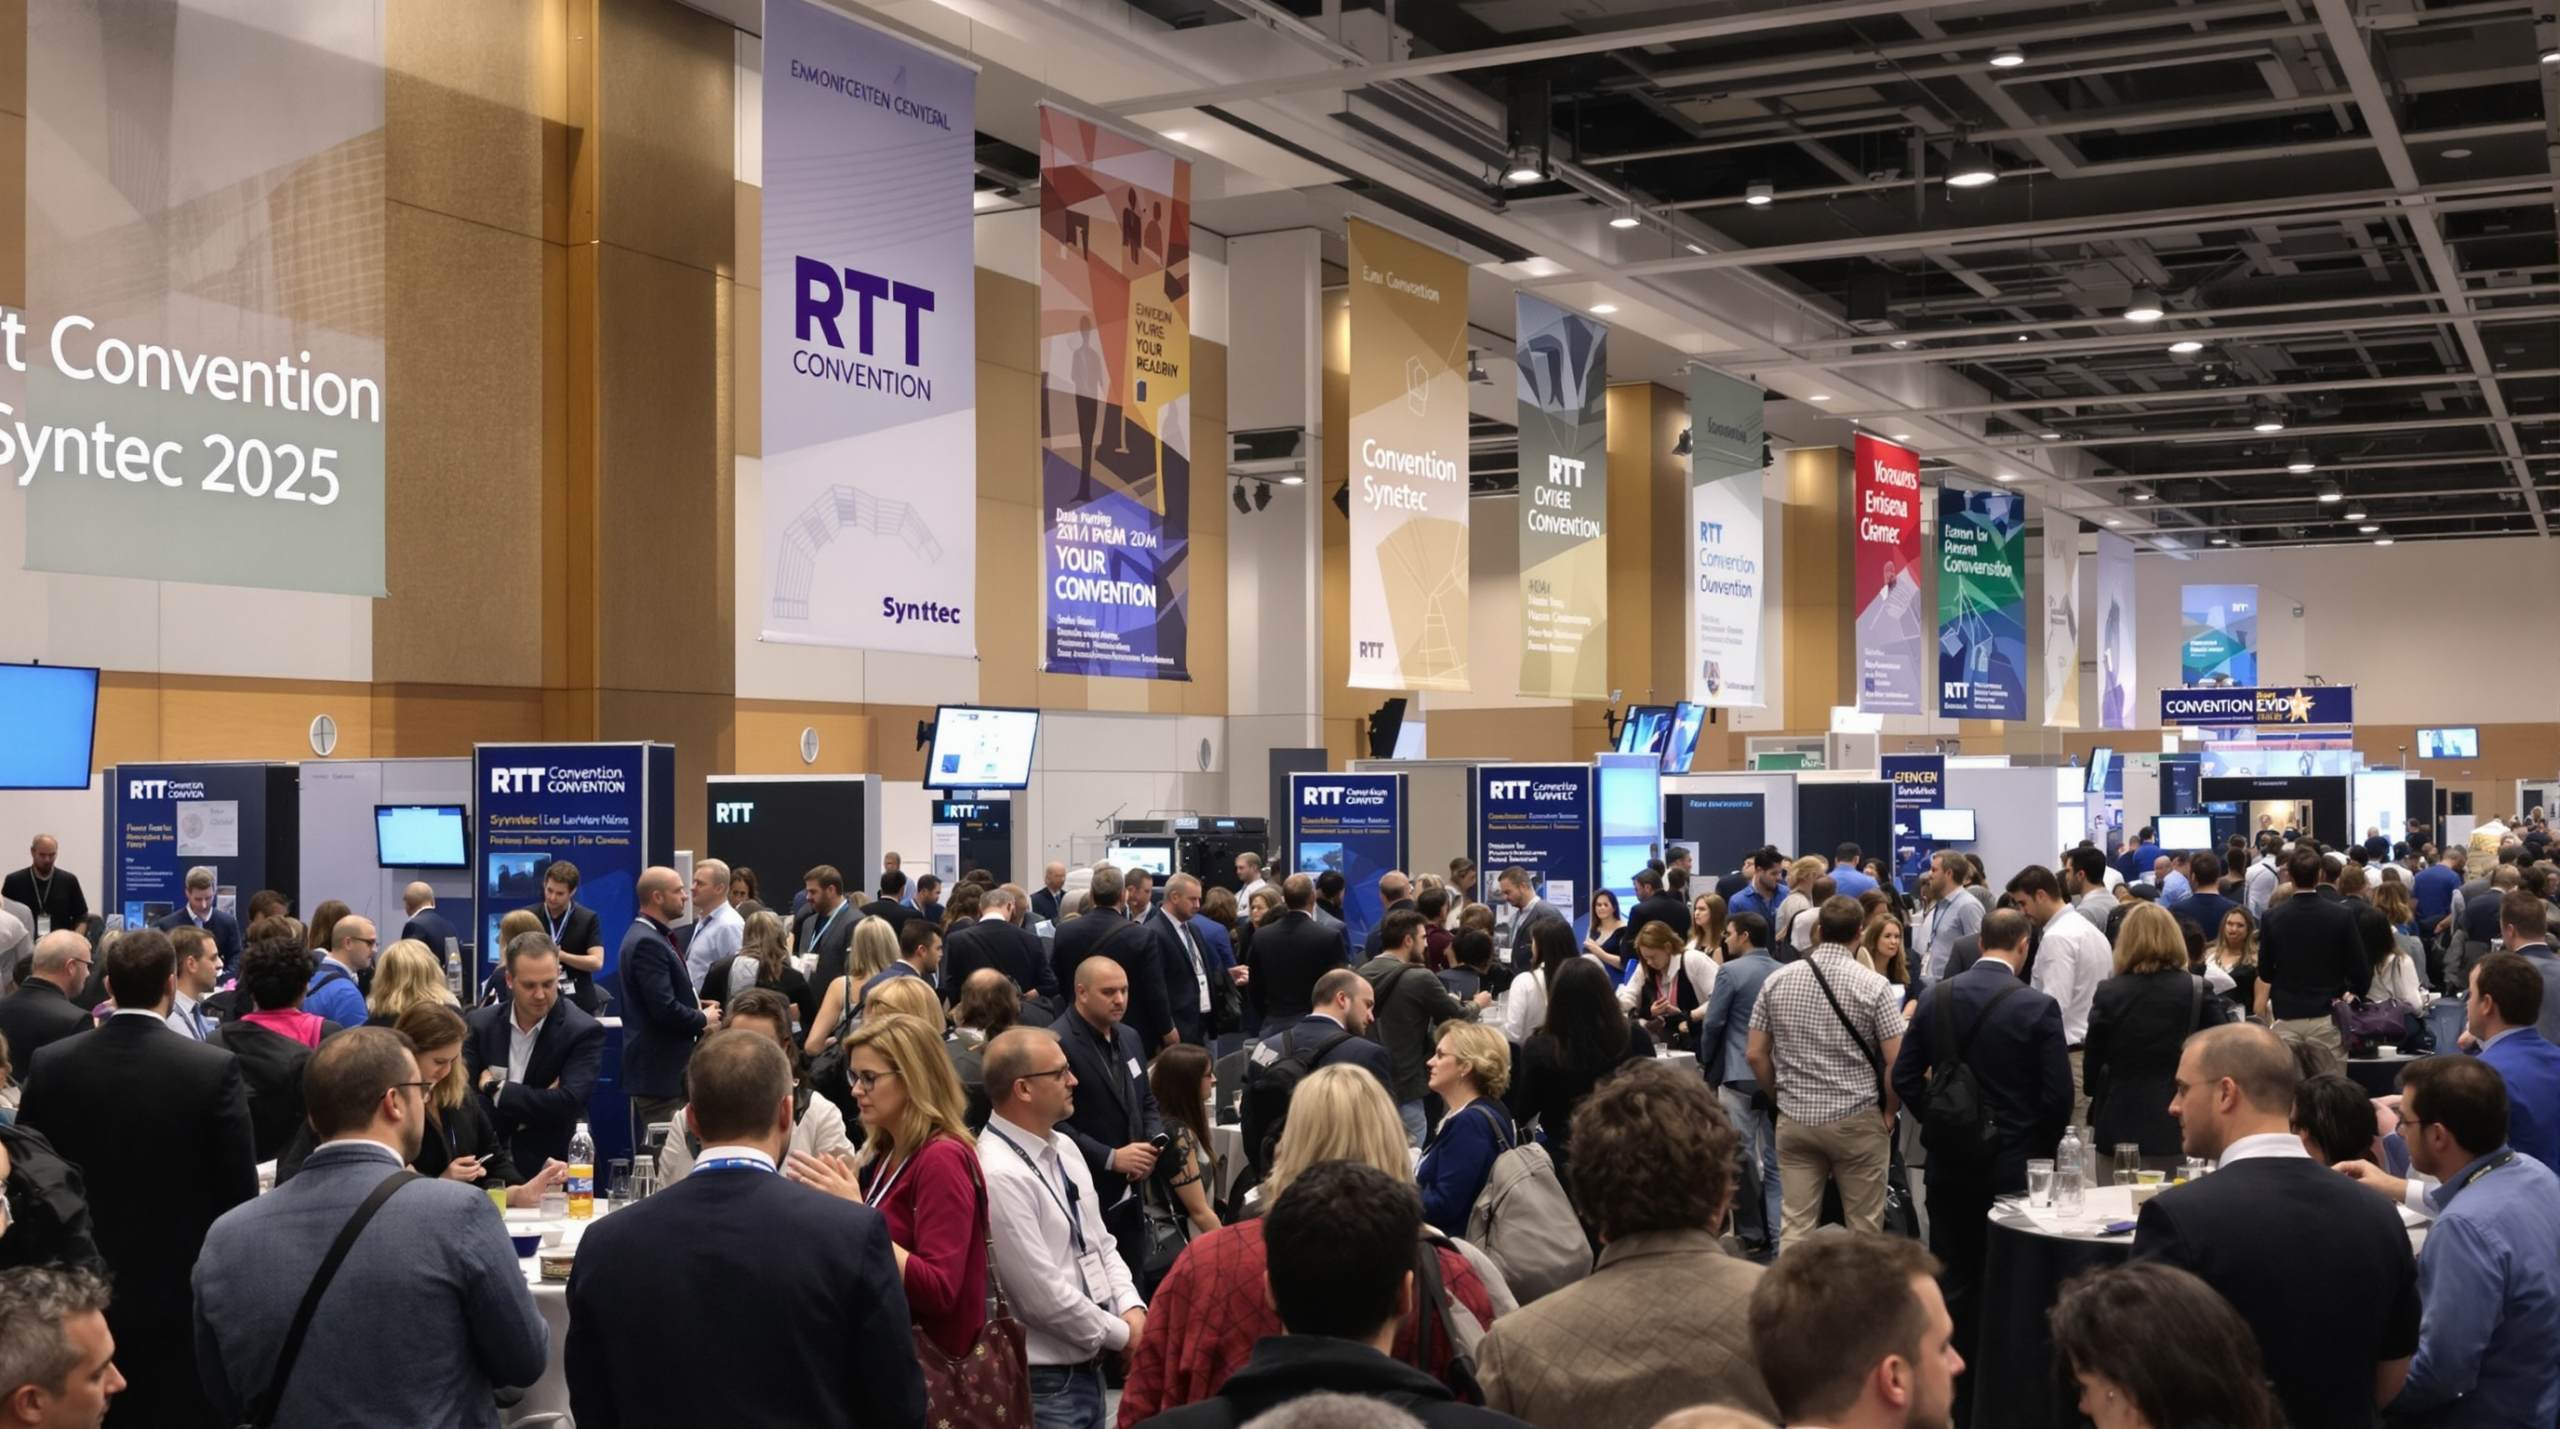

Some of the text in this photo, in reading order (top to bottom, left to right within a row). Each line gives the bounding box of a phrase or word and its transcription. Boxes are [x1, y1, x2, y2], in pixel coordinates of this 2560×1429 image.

[796, 255, 935, 367] RTT
[1136, 338, 1162, 357] YOUR
[0, 305, 380, 422] t Convention
[793, 350, 931, 401] CONVENTION
[202, 434, 340, 505] 2025
[1362, 438, 1457, 482] Convention
[1548, 454, 1586, 488] RTT
[1364, 475, 1428, 511] Synetec
[1700, 521, 1723, 544] RTT
[1055, 545, 1107, 575] YOUR
[1055, 575, 1157, 608] CONVENTION
[1359, 641, 1384, 659] RTT
[1945, 682, 1970, 699] RTT
[2166, 699, 2253, 714] CONVENTION
[130, 779, 168, 799] RTT
[491, 767, 546, 794] RTT
[547, 781, 626, 794] CONVENTION
[1490, 780, 1531, 799] RTT
[1303, 786, 1346, 805] RTT
[716, 802, 754, 823] RTT
[950, 804, 975, 818] RTT
